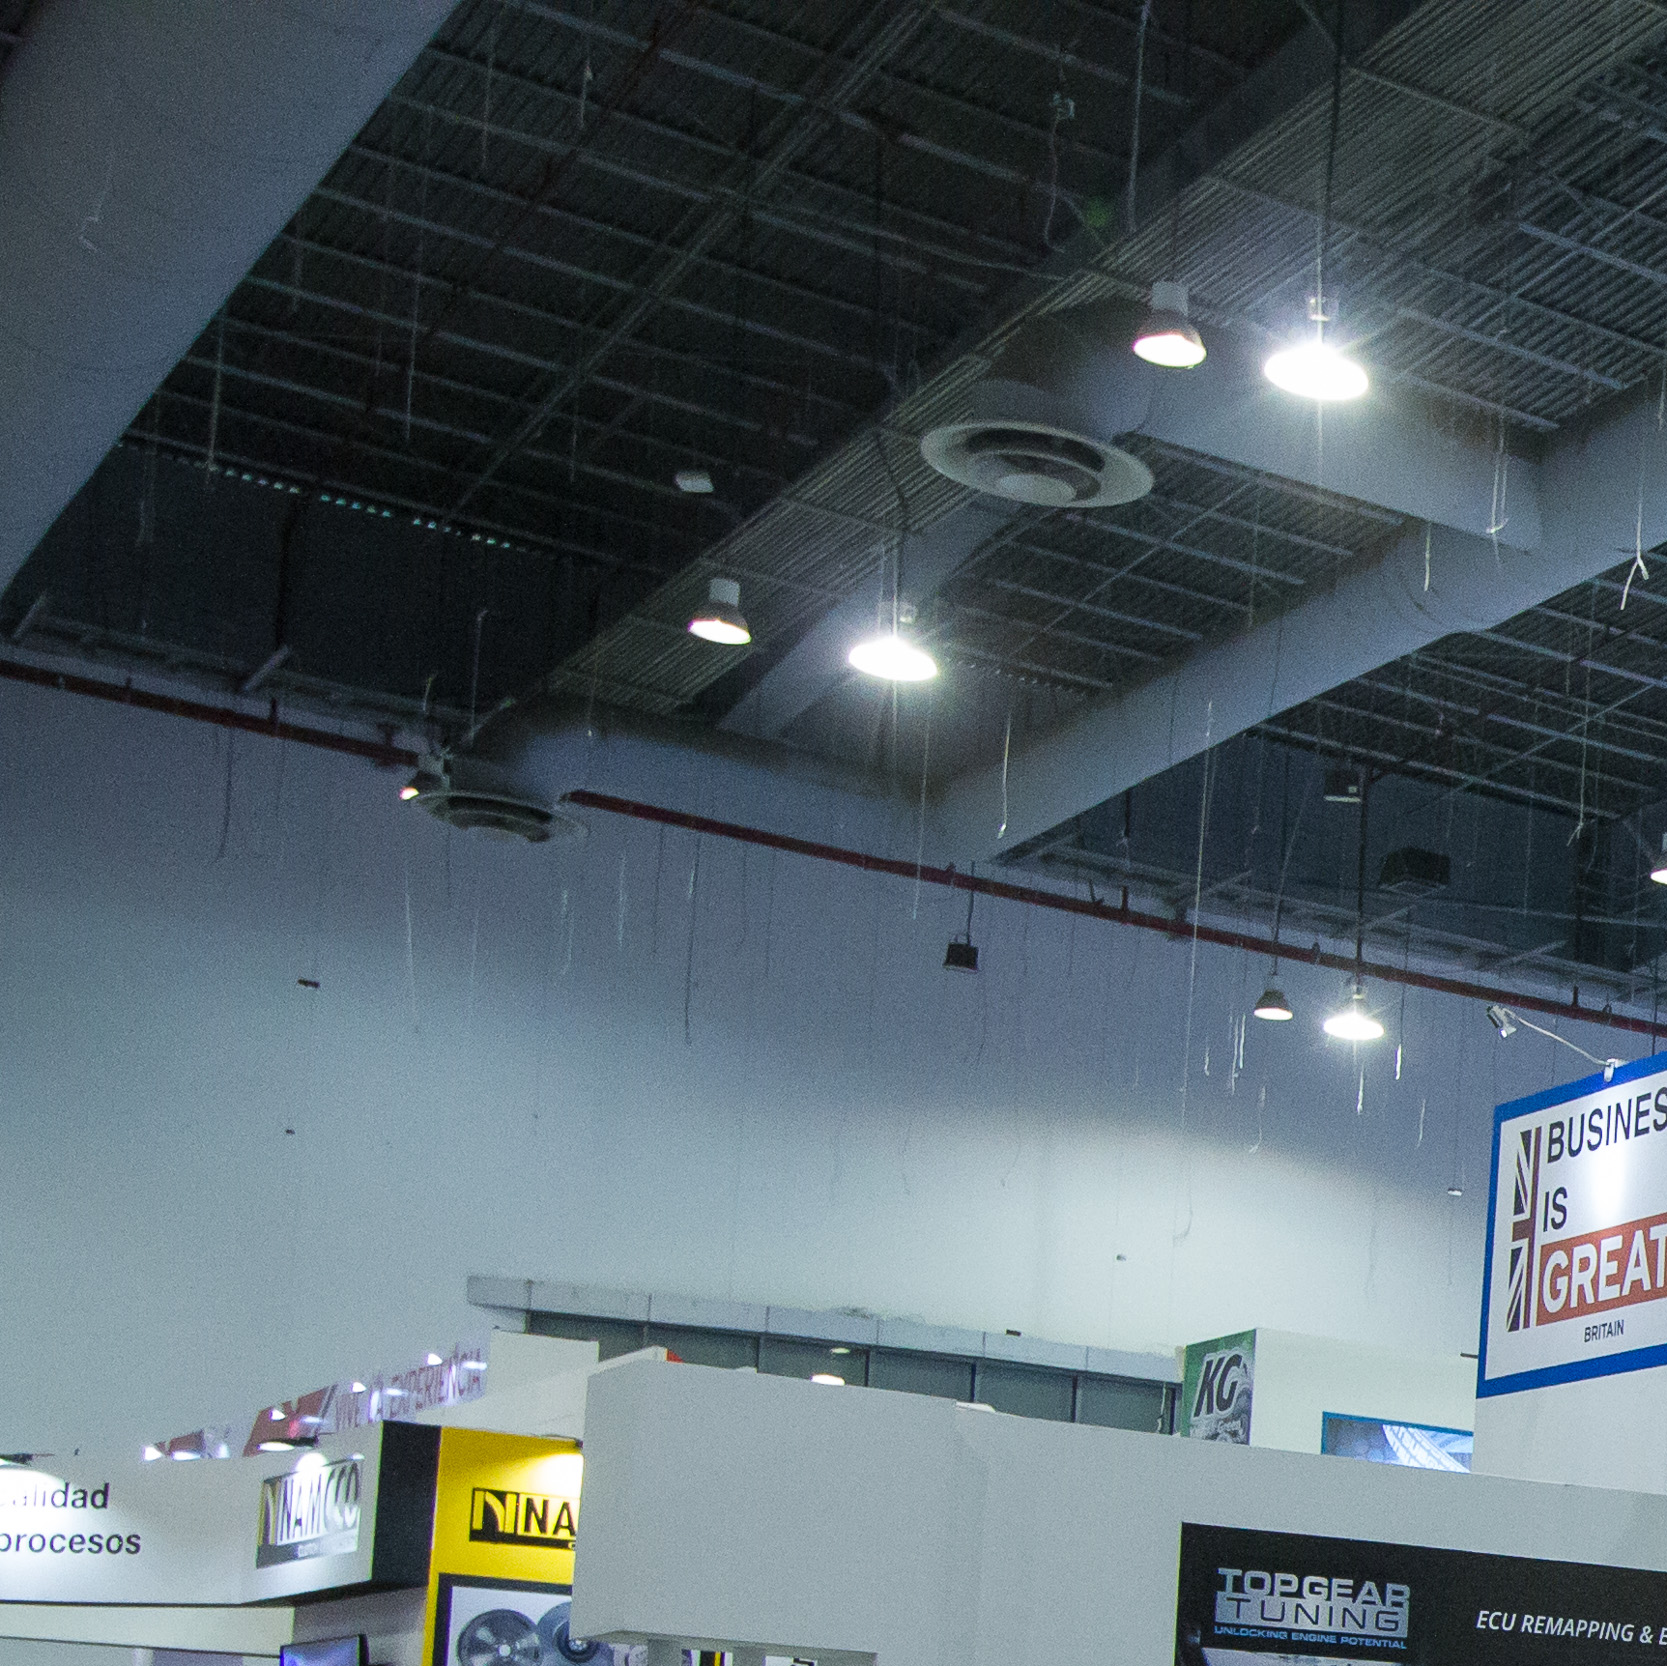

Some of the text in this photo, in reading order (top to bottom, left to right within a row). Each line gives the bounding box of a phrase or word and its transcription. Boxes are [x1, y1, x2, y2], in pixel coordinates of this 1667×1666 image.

[1543, 1187, 1568, 1232] IS
[1584, 1320, 1624, 1343] BRITAIN
[1218, 1567, 1410, 1608] TOPGEAR
[1226, 1600, 1400, 1632] TUNING
[1476, 1610, 1517, 1631] ECU
[1521, 1615, 1634, 1643] REMAPPING
[1639, 1626, 1652, 1644] &
[1214, 1626, 1407, 1650] UNLOCKING ENGINE POTENTIAL
